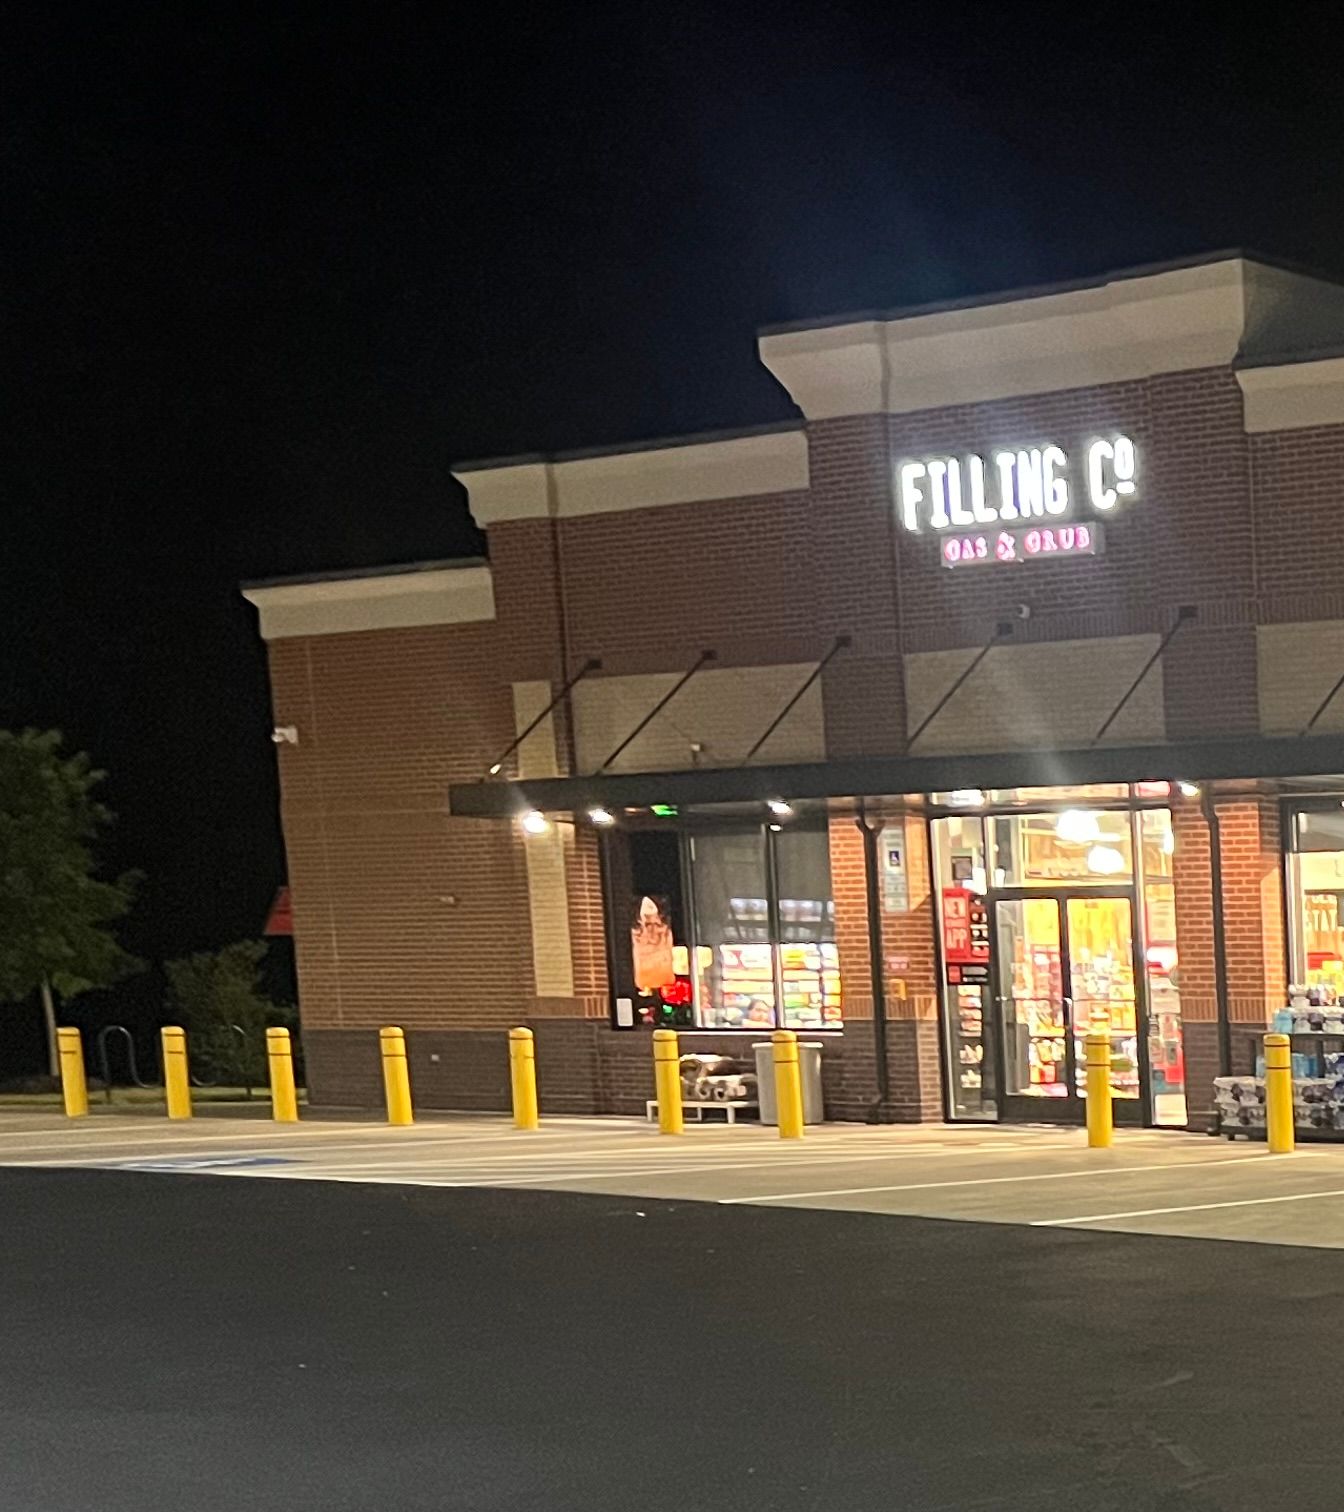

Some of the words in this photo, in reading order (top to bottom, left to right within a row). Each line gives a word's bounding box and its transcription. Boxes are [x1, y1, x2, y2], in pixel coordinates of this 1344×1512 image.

[900, 446, 1069, 531] FILLING
[944, 536, 988, 562] GAS
[995, 531, 1017, 561] &
[1024, 526, 1090, 554] GRUB
